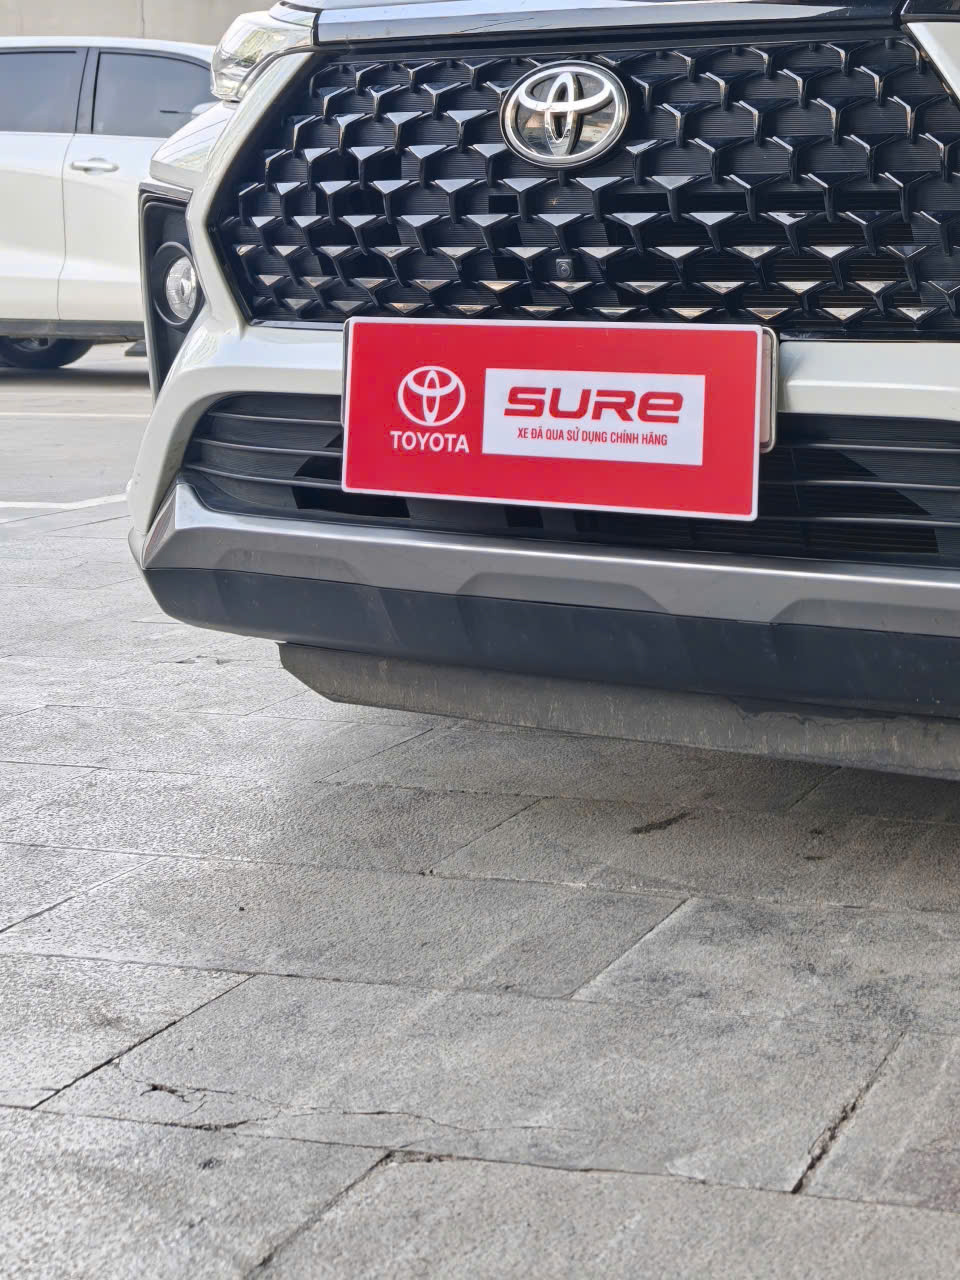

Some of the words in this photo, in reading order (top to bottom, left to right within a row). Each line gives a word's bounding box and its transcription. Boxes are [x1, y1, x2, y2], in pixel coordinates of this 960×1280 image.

[390, 430, 470, 454] TOYOTA
[517, 427, 529, 439] XE
[531, 425, 543, 439] ĐÃ
[545, 428, 565, 441] QUA
[581, 430, 608, 445] DỤNG
